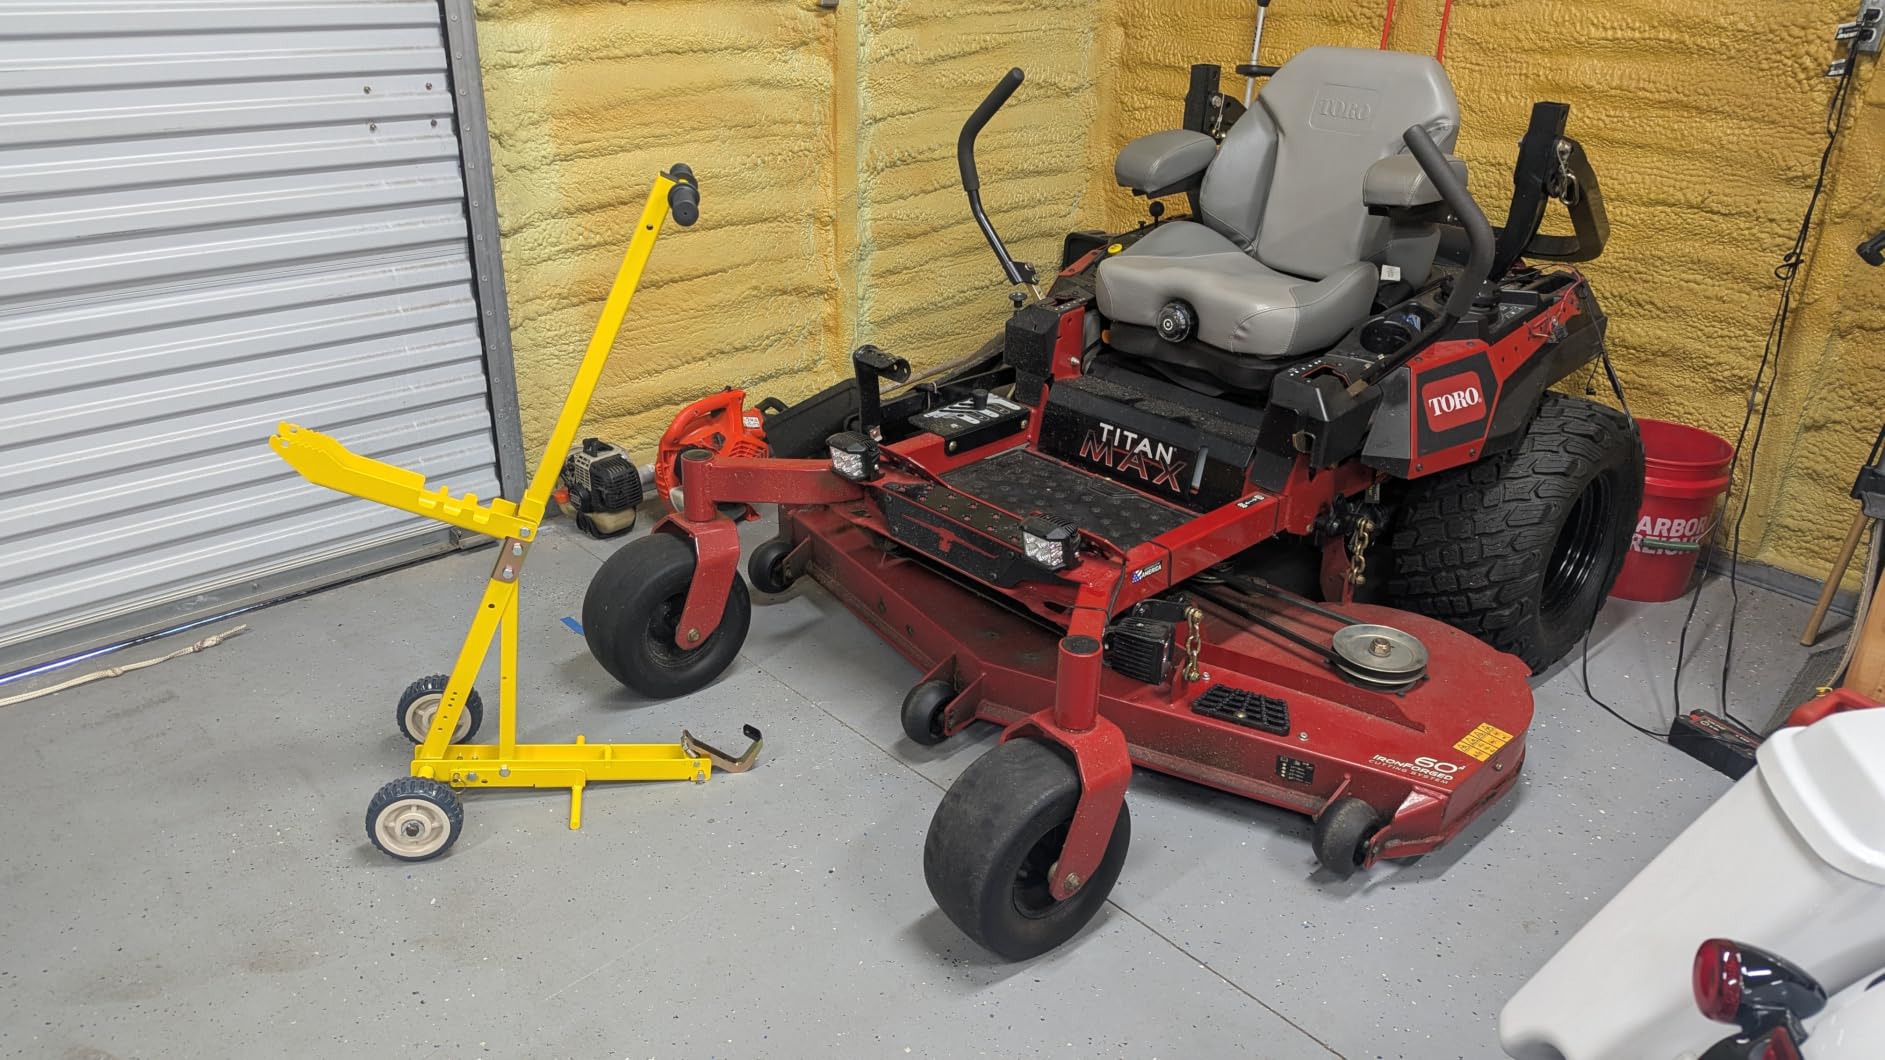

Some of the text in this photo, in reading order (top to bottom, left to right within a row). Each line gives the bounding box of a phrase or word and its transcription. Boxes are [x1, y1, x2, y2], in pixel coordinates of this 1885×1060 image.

[1318, 97, 1372, 120] TORO
[1428, 386, 1479, 417] TORO
[1099, 422, 1174, 465] TITAN
[1079, 429, 1188, 493] MAX
[1636, 515, 1708, 537] ARBOR
[1368, 759, 1449, 785] CUTTING SYSTEM
[1372, 754, 1454, 781] IRONFORGED
